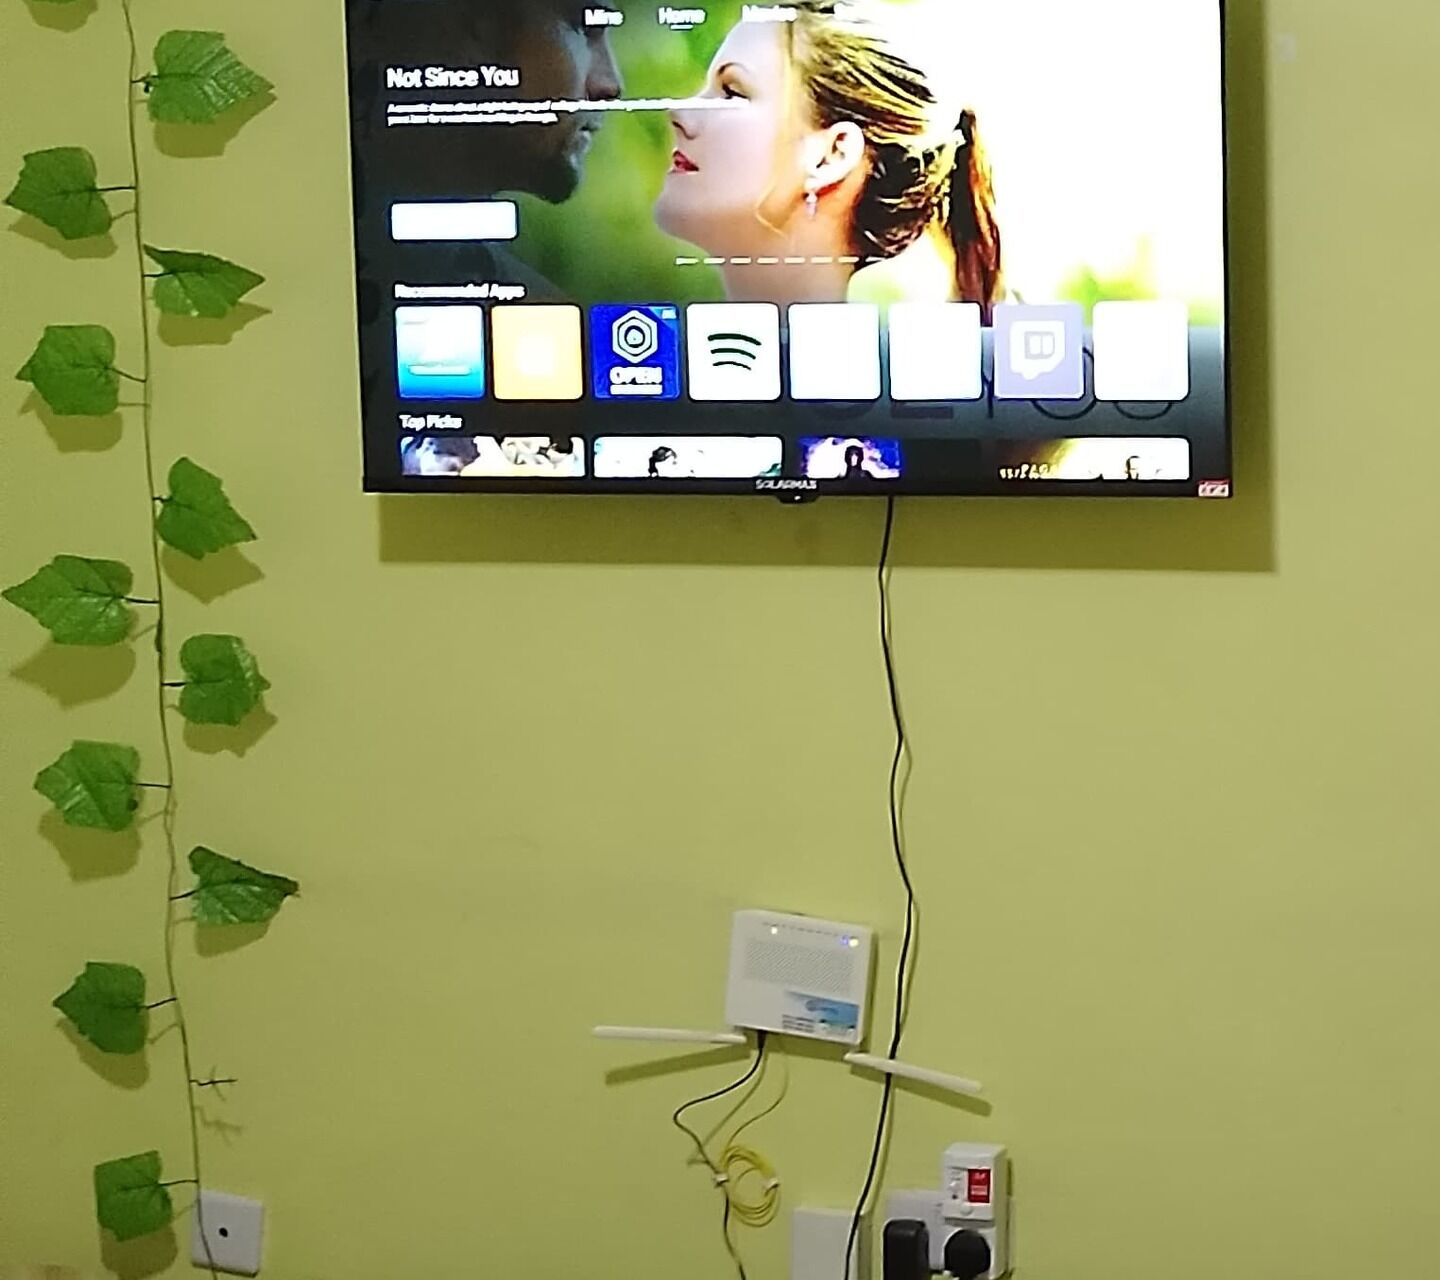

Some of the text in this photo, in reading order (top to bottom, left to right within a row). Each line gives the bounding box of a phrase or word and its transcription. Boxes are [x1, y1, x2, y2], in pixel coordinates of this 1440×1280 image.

[658, 7, 706, 23] Home
[386, 66, 519, 87] Not Since You
[399, 415, 425, 431] Top
